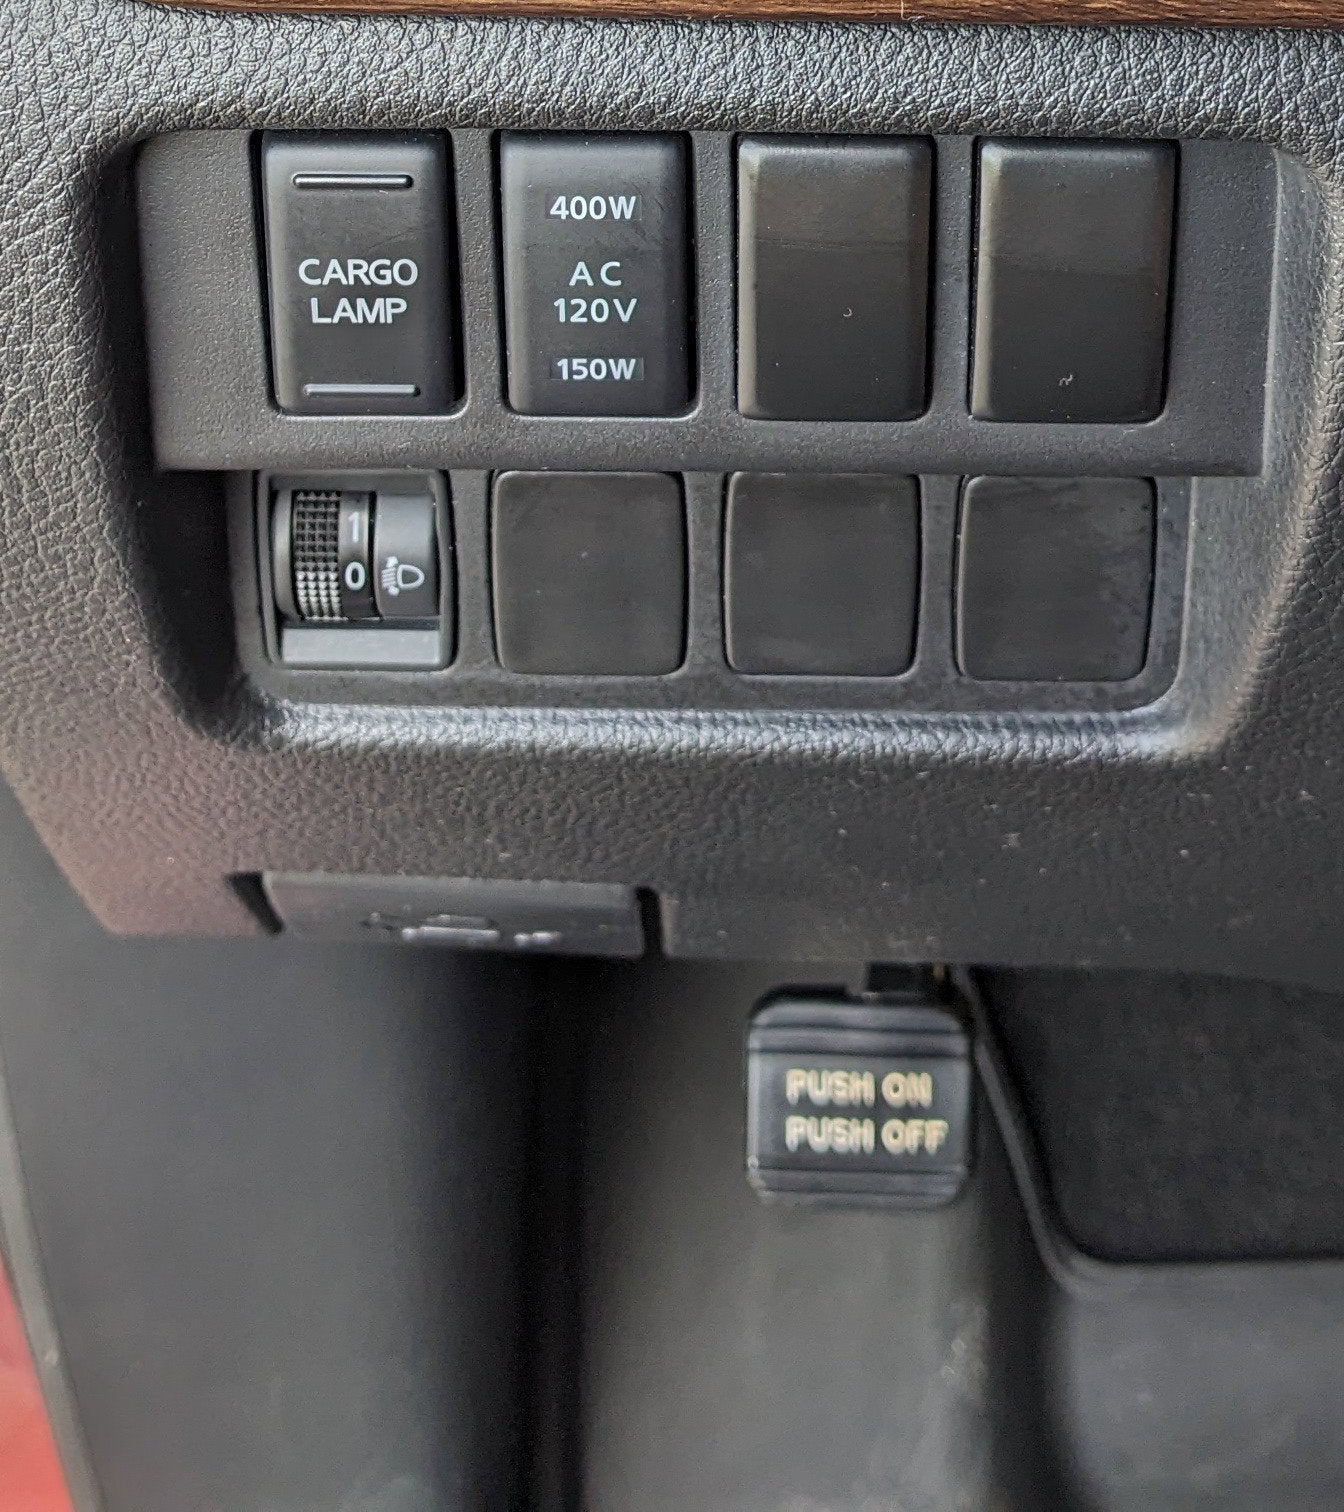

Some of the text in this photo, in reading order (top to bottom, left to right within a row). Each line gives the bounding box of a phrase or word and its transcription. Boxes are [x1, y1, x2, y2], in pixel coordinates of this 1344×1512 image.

[549, 195, 637, 221] 400W
[297, 258, 418, 286] CARGO
[310, 297, 408, 324] LAMP
[553, 297, 637, 323] 120V
[556, 358, 637, 381] 150W
[785, 1068, 933, 1108] PUSH ON
[784, 1115, 949, 1155] PUSH OFF
